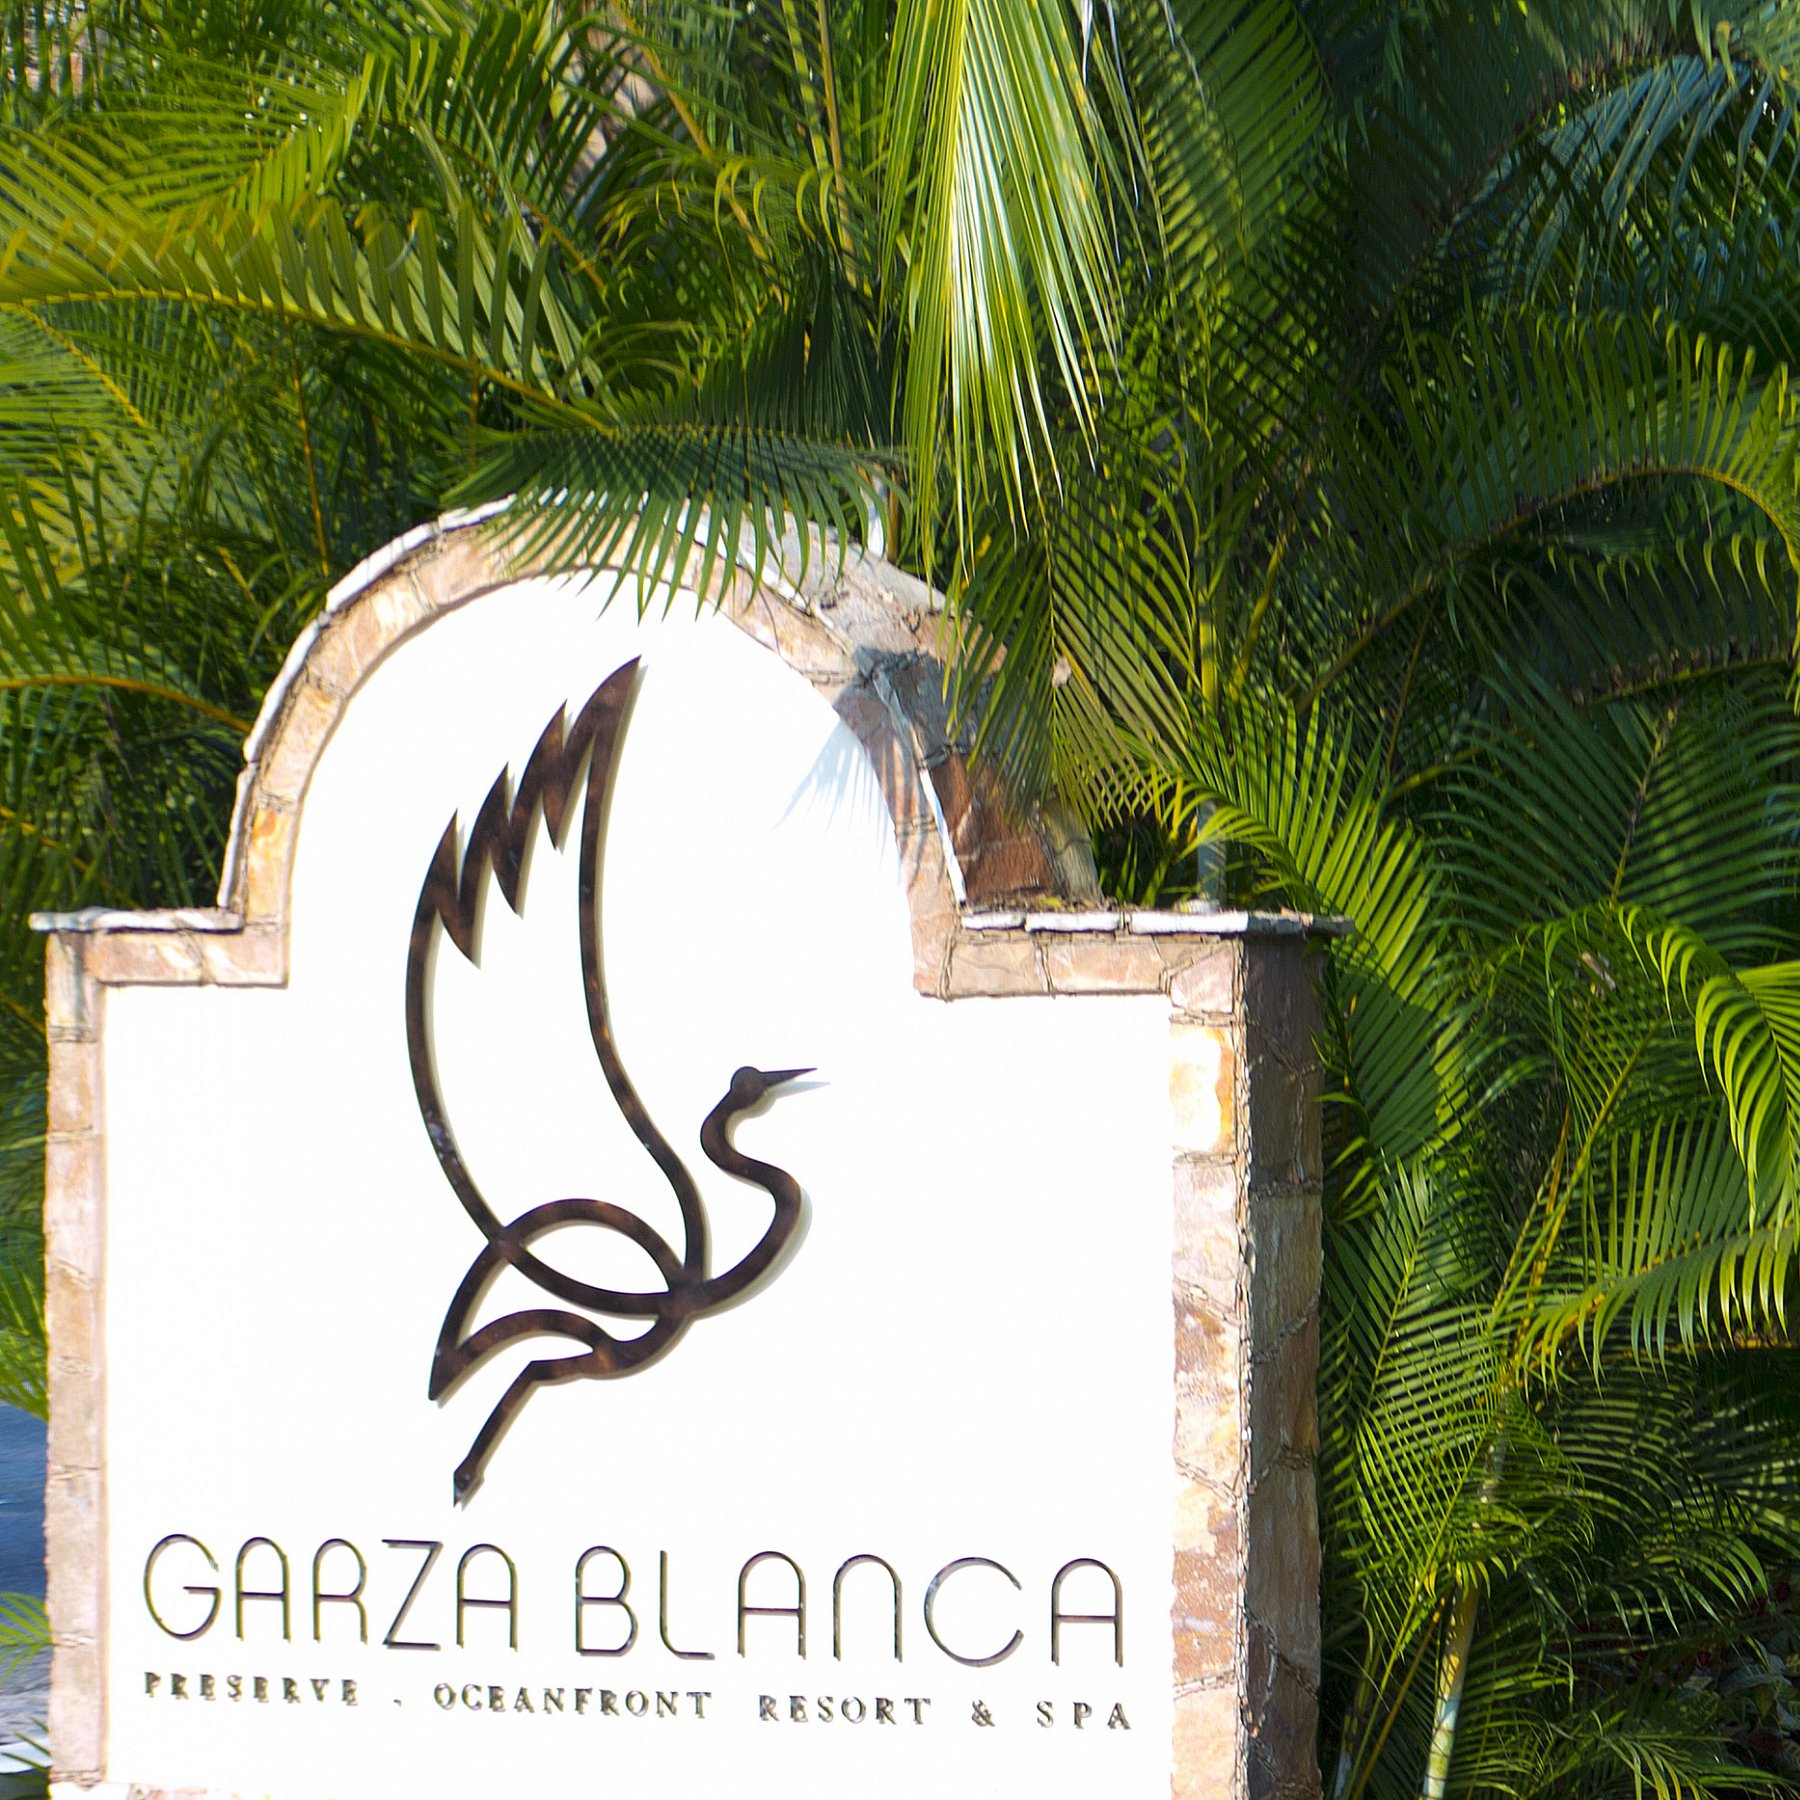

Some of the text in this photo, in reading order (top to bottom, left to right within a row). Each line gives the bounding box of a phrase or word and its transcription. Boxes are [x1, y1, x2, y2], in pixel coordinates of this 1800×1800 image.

[143, 1533, 1124, 1668] GARZA BLANCA
[144, 1671, 359, 1706] PRESERVE
[433, 1682, 712, 1719] OCEANFRONT
[758, 1694, 931, 1725] RESORT
[971, 1699, 996, 1727] &
[1036, 1700, 1131, 1731] SPA
